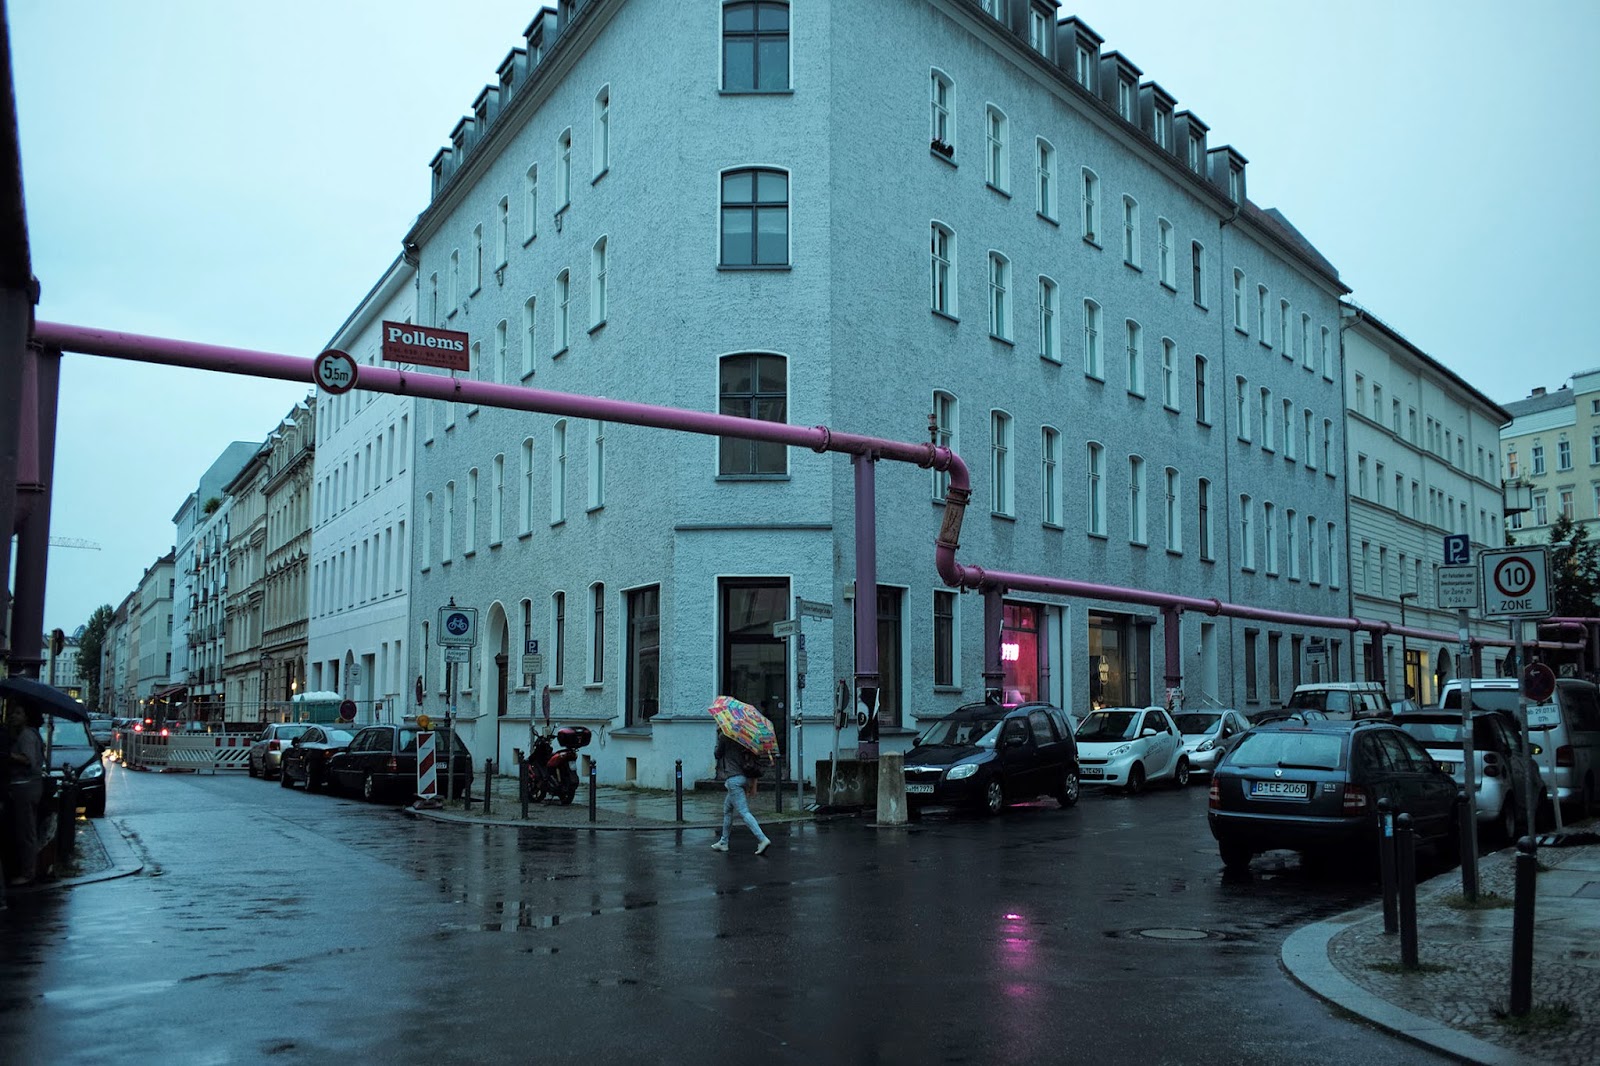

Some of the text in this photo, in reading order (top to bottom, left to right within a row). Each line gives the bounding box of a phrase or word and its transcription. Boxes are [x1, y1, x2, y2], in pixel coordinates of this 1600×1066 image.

[388, 327, 464, 351] Pollems
[1449, 538, 1464, 562] P
[1504, 567, 1526, 587] 10
[1500, 599, 1532, 611] ZONE
[528, 641, 537, 652] P
[1257, 782, 1306, 794] B EE 2060
